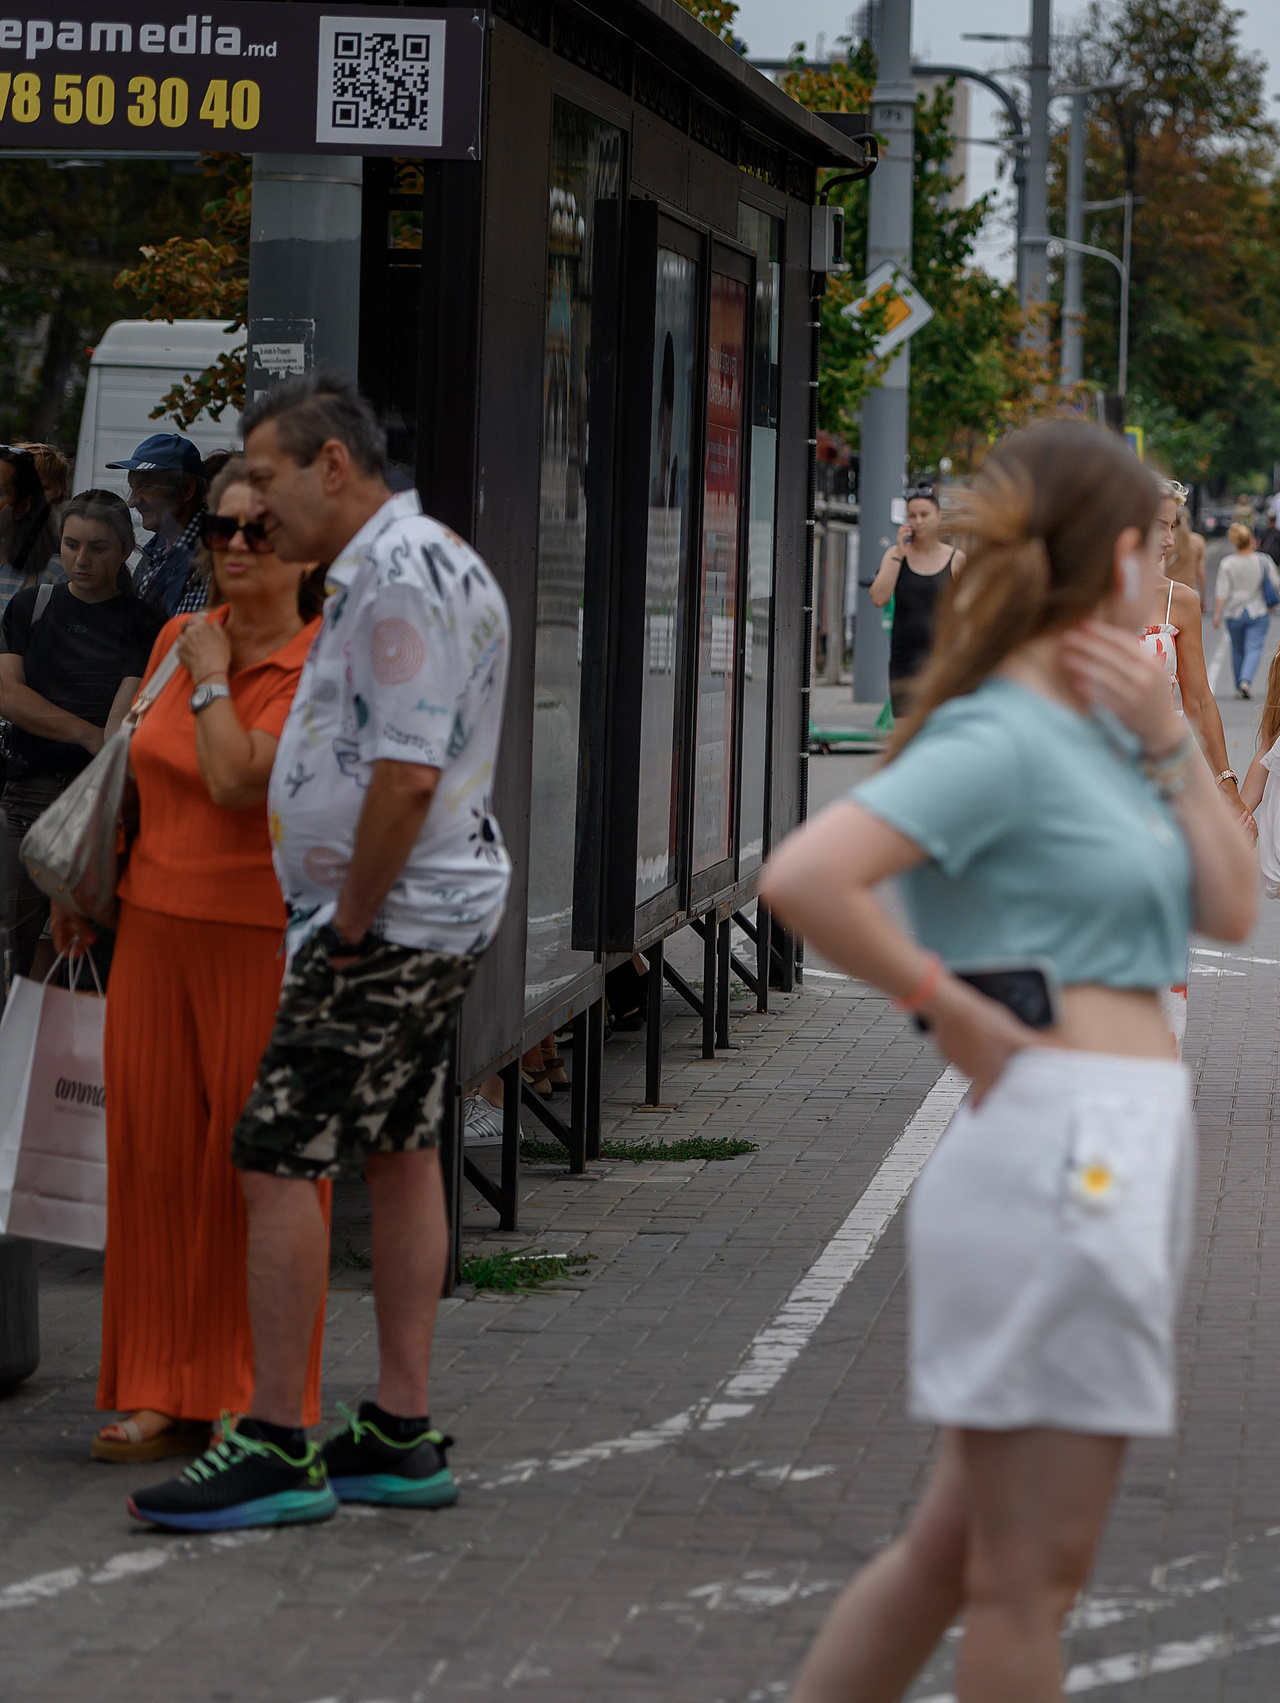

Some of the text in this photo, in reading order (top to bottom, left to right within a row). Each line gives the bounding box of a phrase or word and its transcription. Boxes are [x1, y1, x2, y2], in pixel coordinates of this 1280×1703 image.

[53, 74, 115, 126] 50
[127, 76, 189, 128] 30
[199, 79, 260, 131] 40
